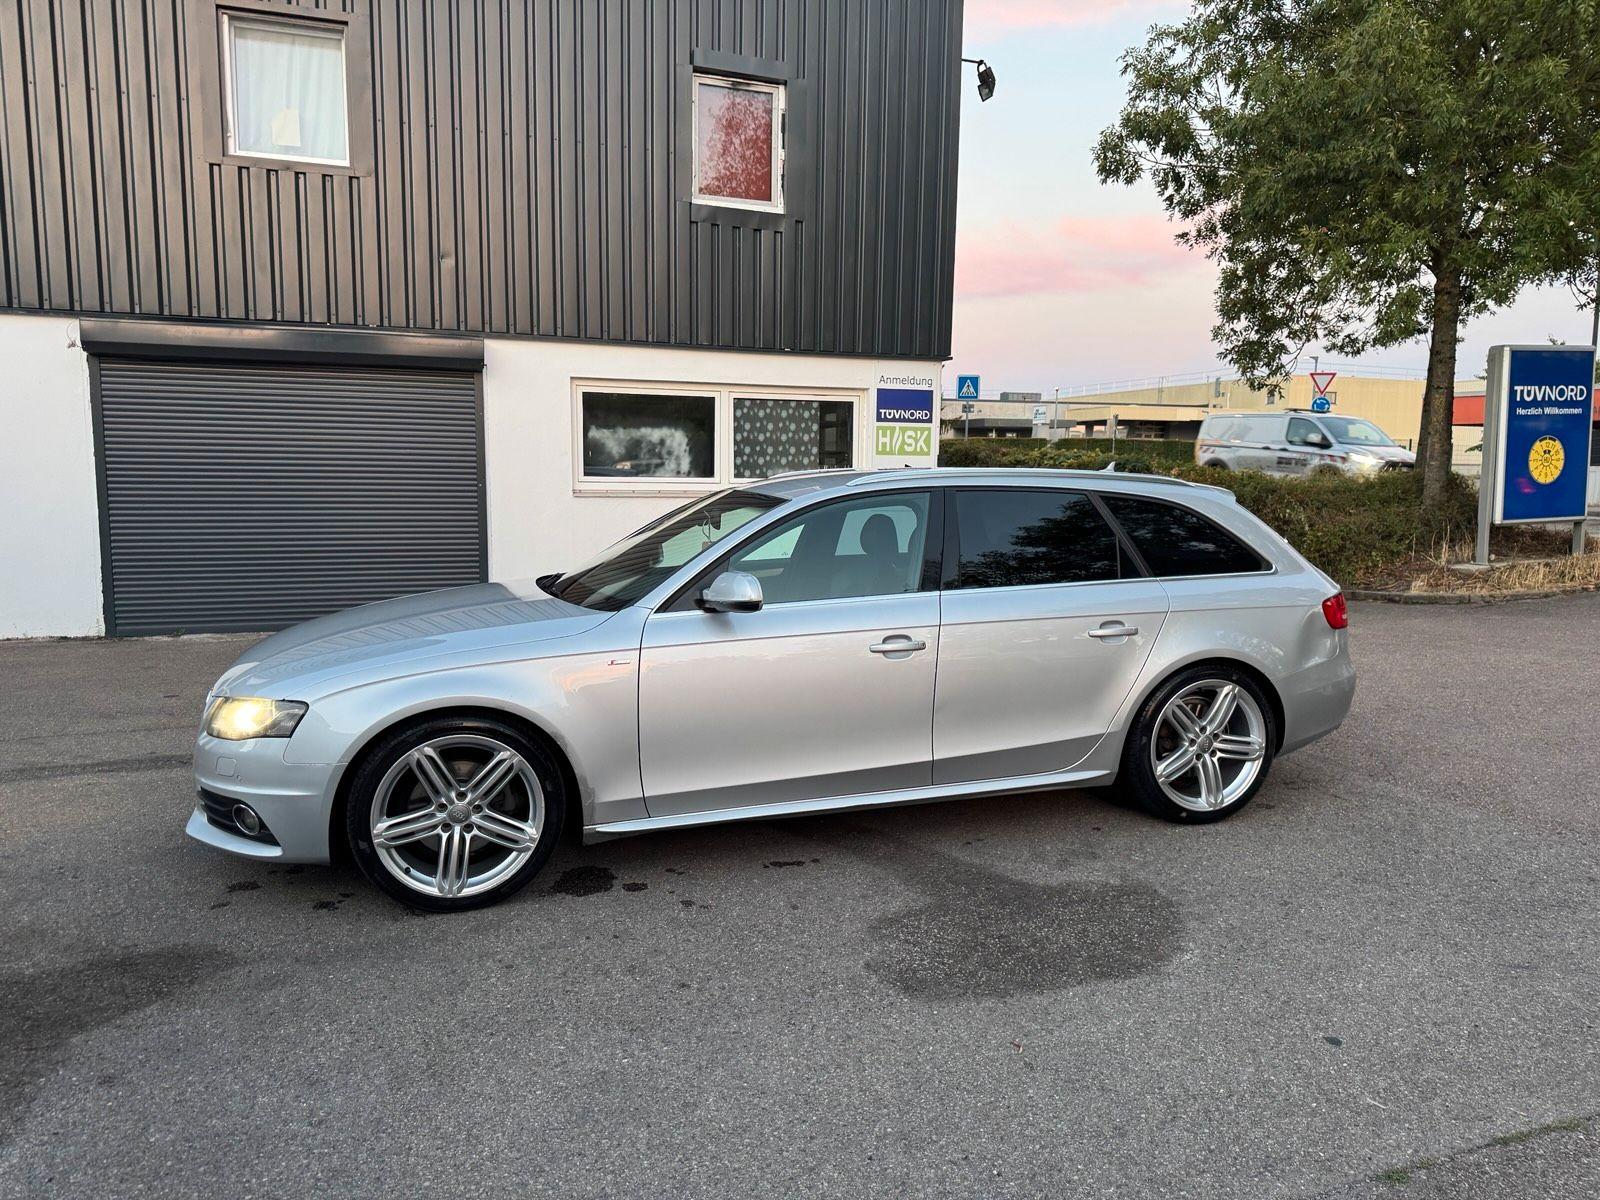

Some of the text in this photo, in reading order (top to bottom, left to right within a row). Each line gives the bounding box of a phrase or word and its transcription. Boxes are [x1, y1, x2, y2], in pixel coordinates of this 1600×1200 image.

[879, 375, 933, 387] Anmeldung
[1516, 406, 1583, 415] Herzlich Willkommen
